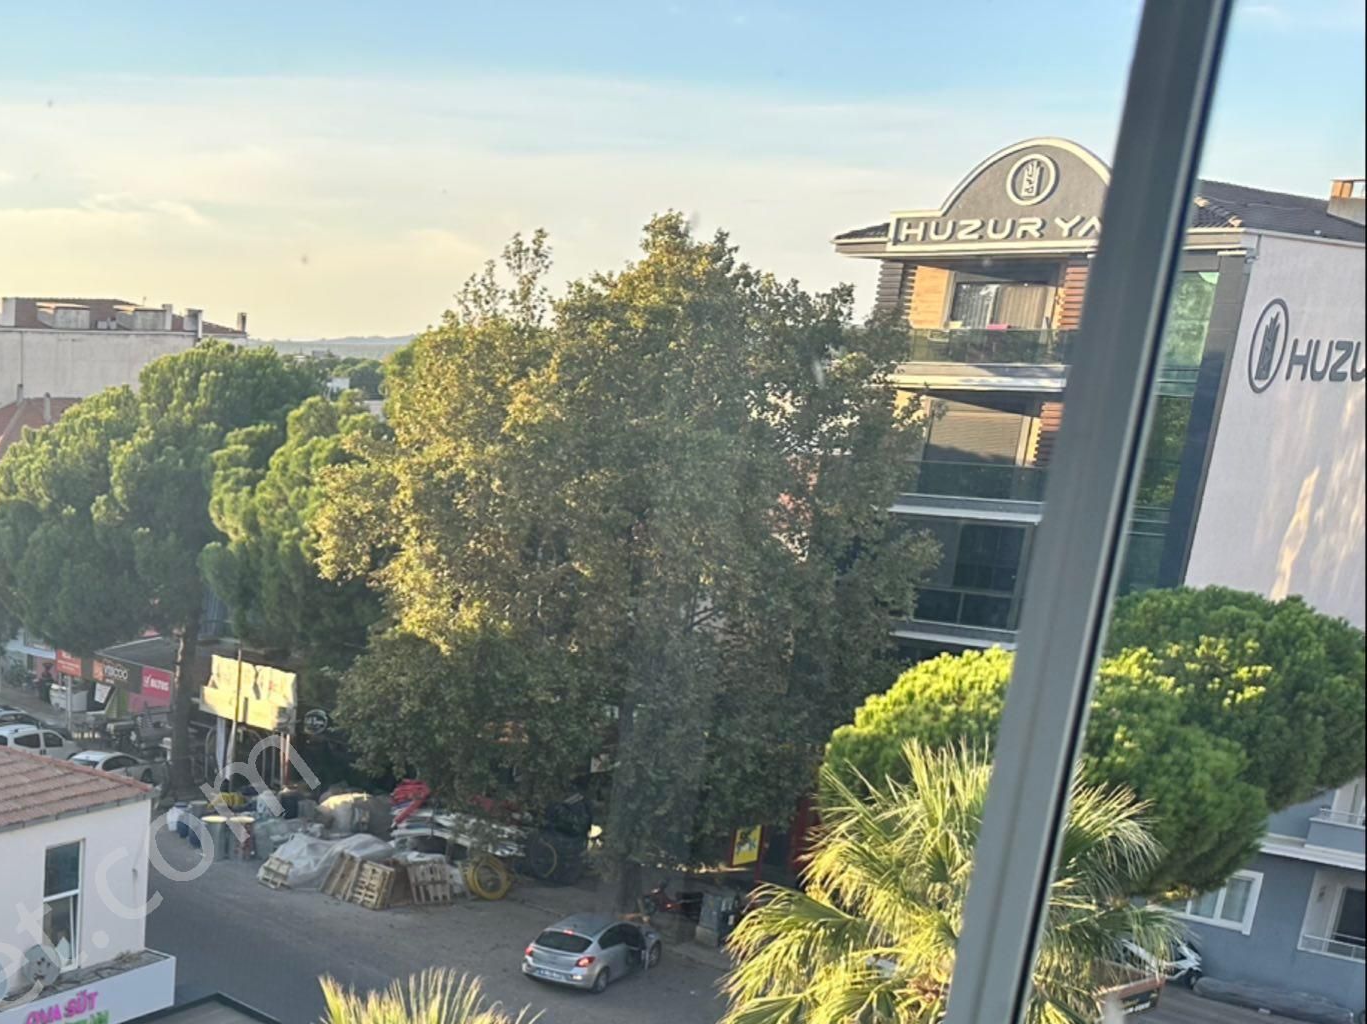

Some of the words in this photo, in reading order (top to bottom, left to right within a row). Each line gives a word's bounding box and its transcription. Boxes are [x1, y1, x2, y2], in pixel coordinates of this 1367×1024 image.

[900, 217, 1044, 242] HUZUR
[1054, 215, 1101, 238] YA
[1285, 338, 1365, 382] HUZU
[64, 989, 98, 1018] SÜT
